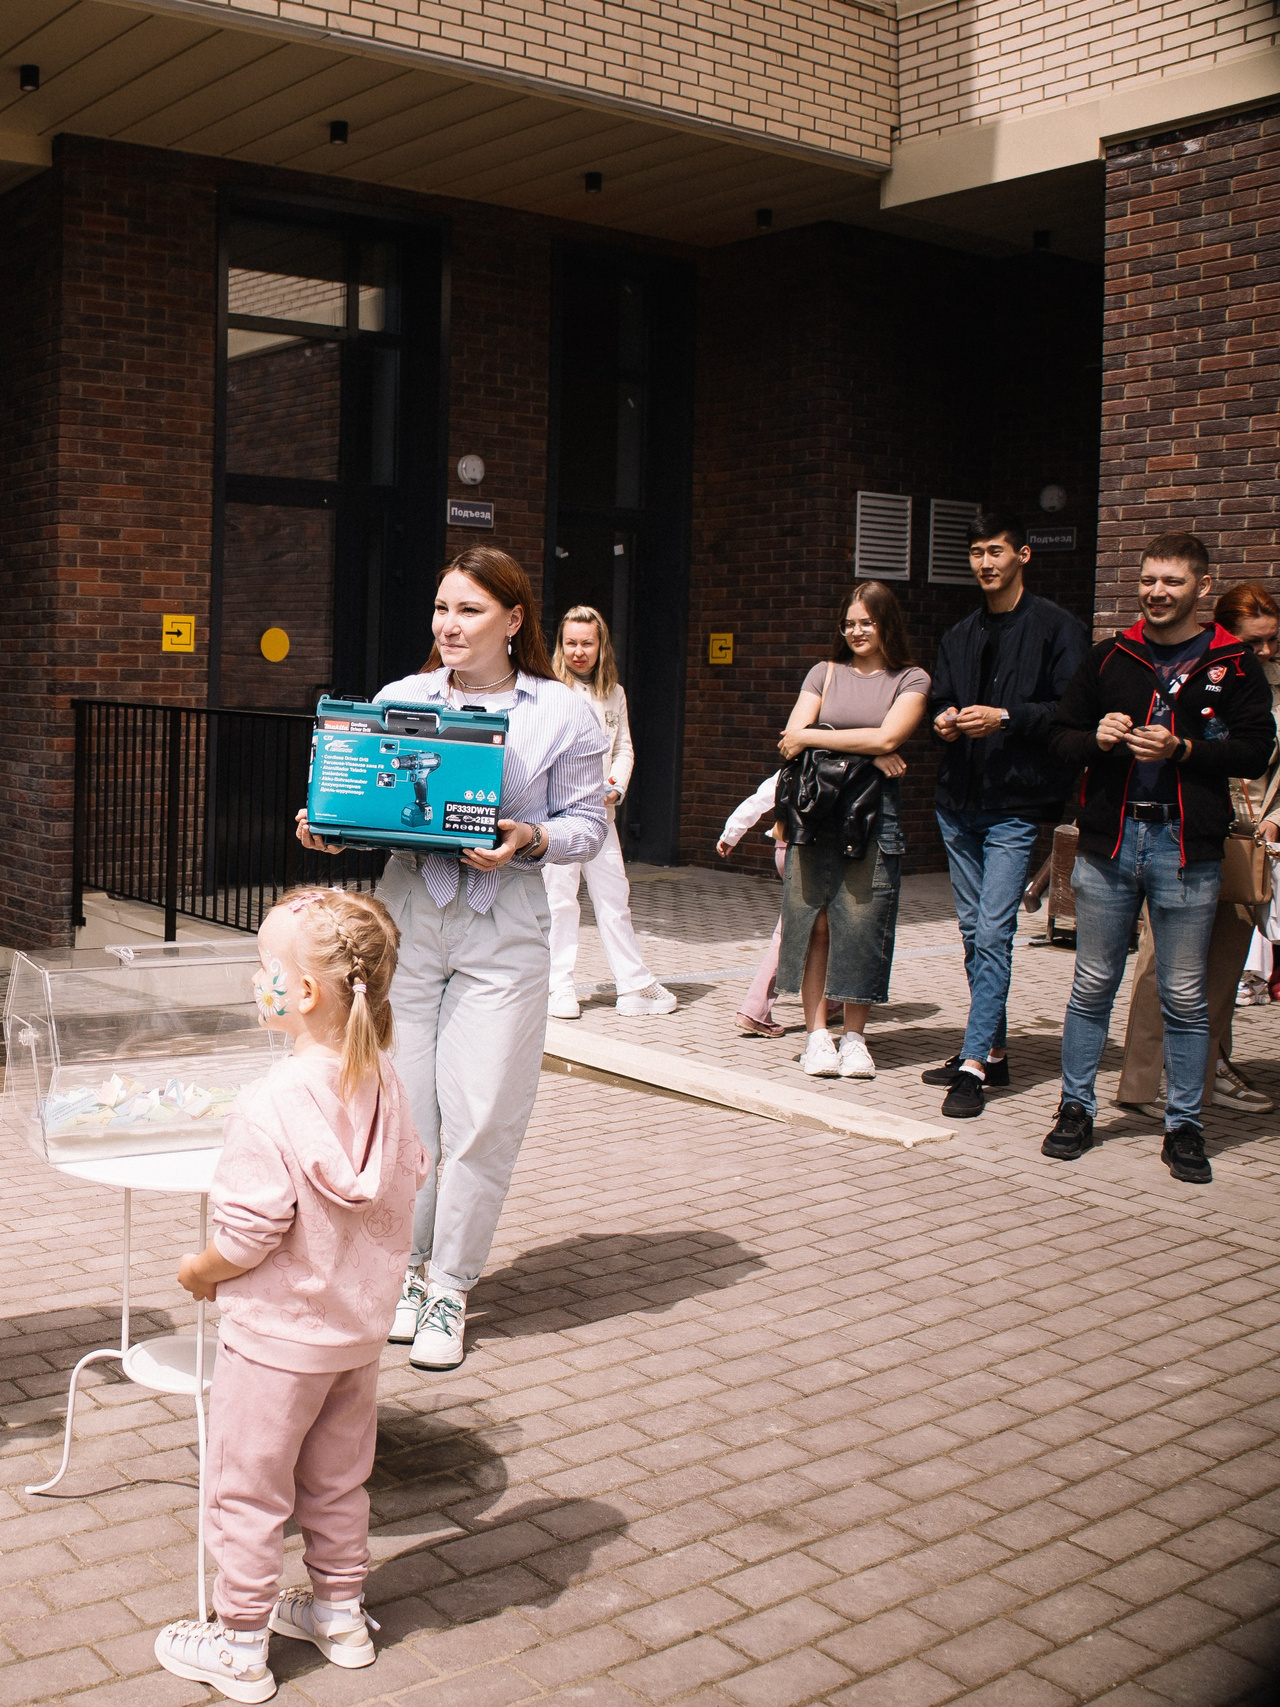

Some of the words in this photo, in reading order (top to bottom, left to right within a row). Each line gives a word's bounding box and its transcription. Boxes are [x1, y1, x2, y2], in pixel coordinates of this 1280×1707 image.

[451, 507, 491, 520] Подъезд
[1030, 535, 1072, 544] Подъезд
[1205, 684, 1222, 693] msi
[446, 803, 496, 816] DF333DWYE
